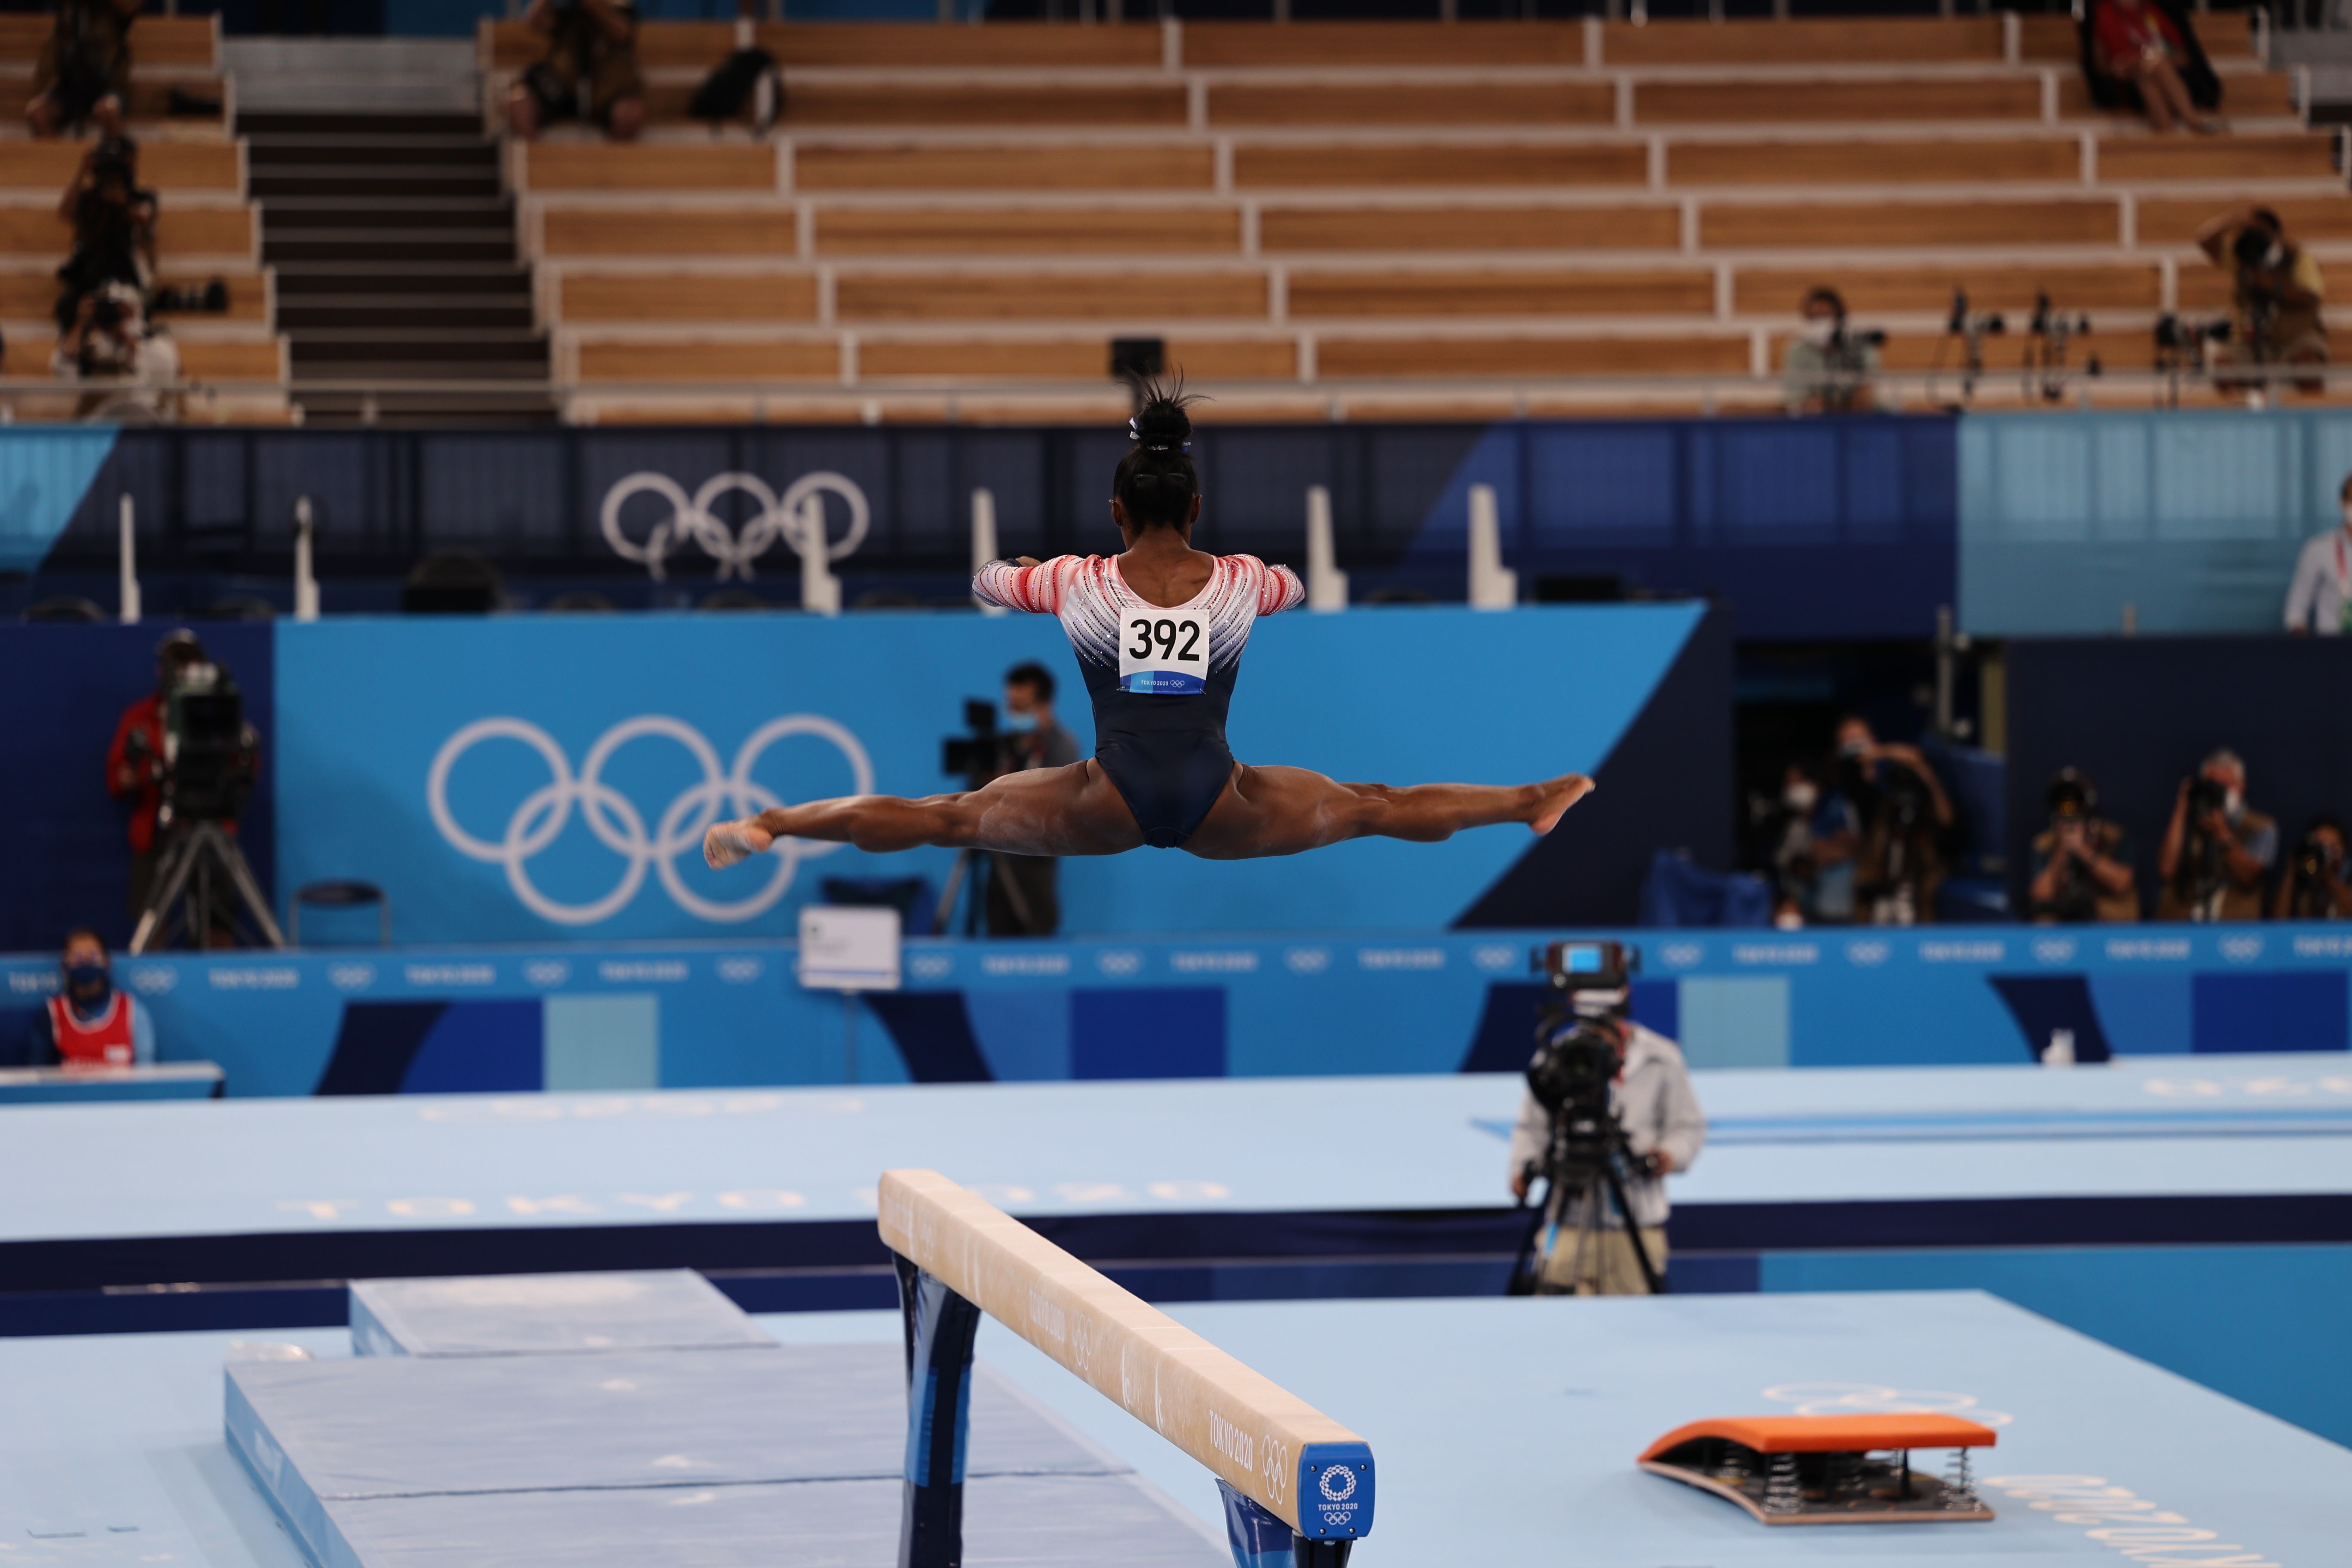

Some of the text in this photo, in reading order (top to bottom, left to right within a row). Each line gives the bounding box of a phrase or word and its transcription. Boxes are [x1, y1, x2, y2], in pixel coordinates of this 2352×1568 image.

[1129, 619, 1200, 662] 392
[1209, 1409, 1253, 1472] TOKYO 2020
